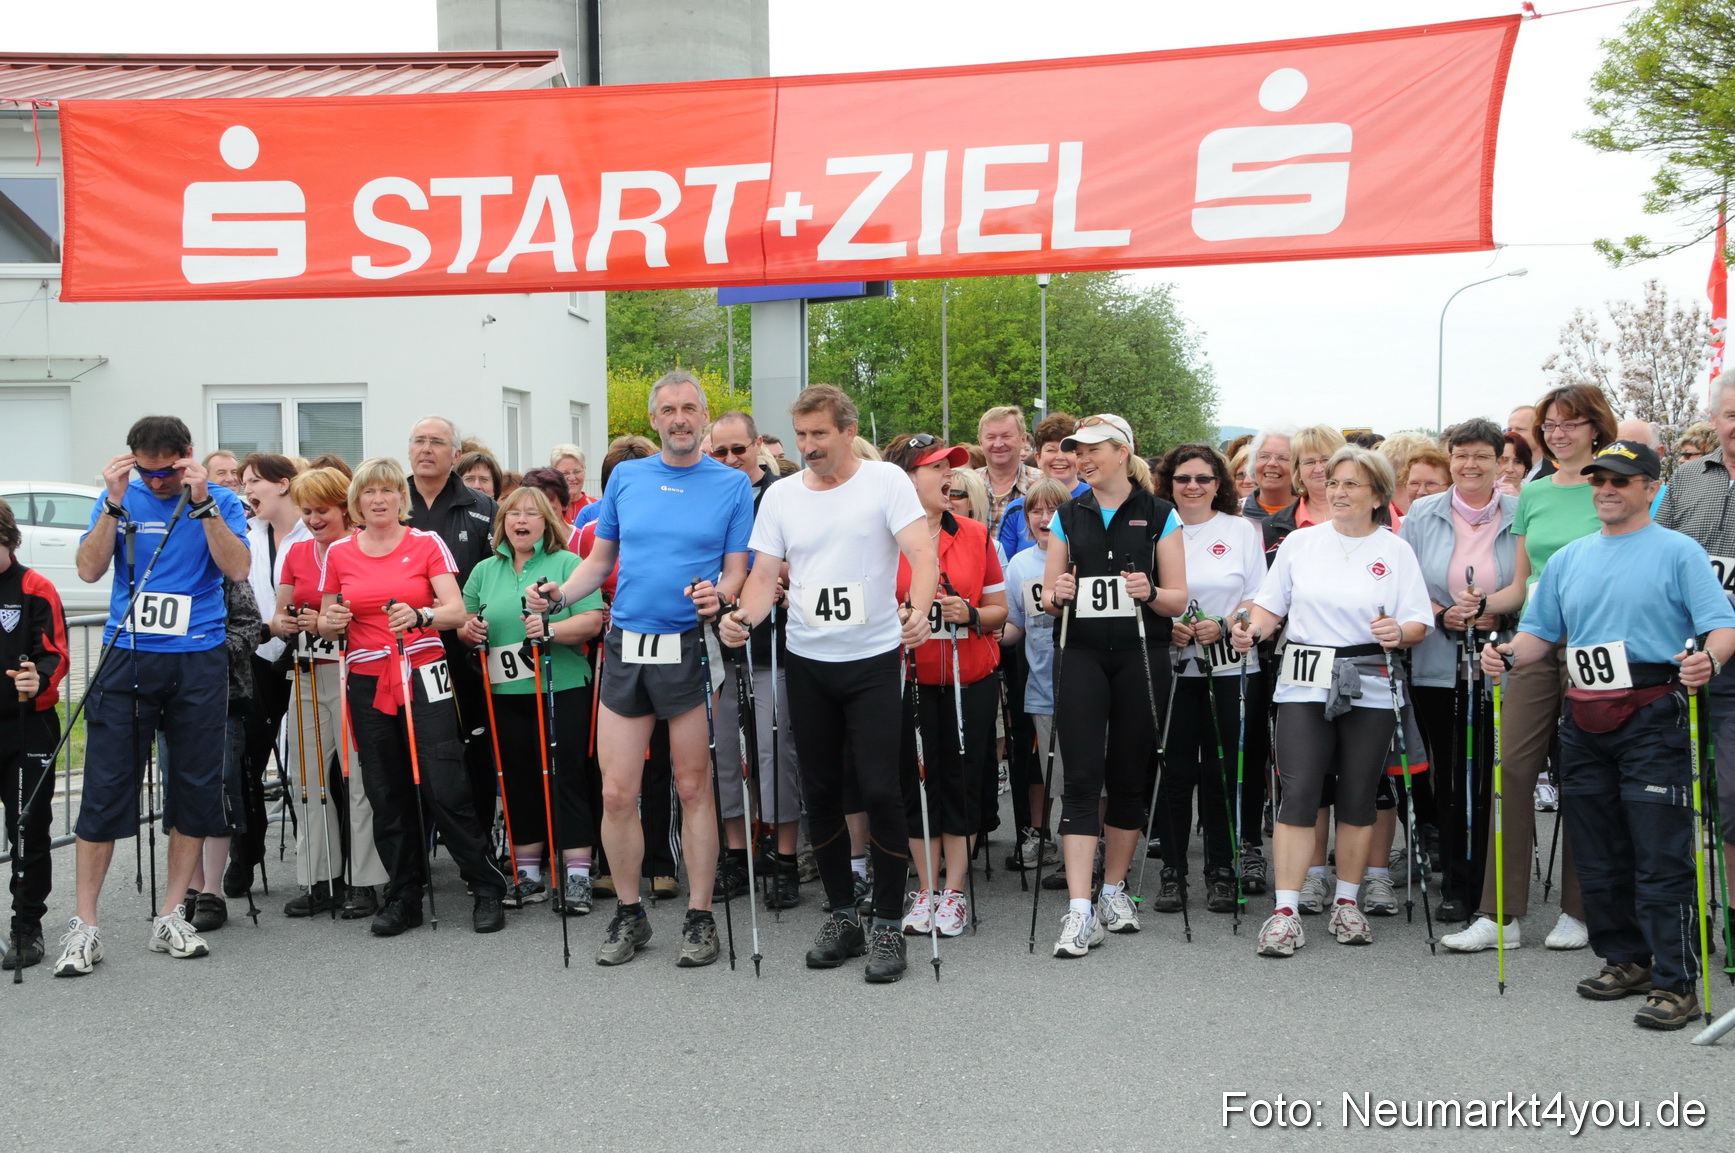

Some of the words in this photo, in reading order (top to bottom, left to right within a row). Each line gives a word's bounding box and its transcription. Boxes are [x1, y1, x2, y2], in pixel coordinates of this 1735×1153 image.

[141, 595, 179, 629] 50
[815, 586, 851, 622] 45
[1092, 578, 1119, 612] 91
[1293, 648, 1322, 683] 117
[1575, 646, 1615, 686] 89
